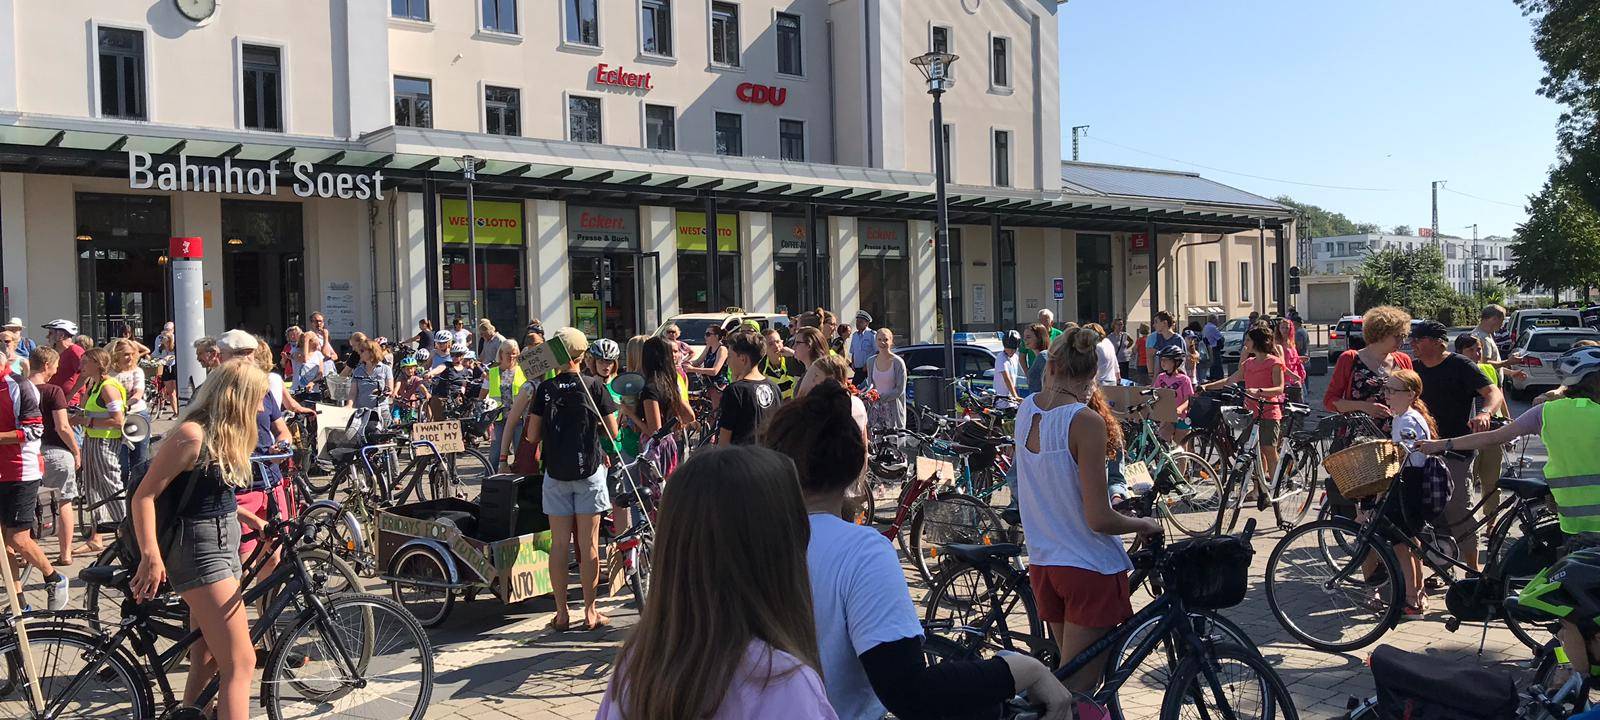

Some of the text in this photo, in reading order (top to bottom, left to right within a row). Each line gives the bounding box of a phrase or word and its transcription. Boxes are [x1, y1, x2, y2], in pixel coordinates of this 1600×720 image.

[595, 63, 654, 90] Eckert.
[735, 82, 788, 106] CDU
[128, 150, 385, 200] Bahnhof Soest
[421, 424, 444, 432] WANT
[446, 422, 459, 430] TO
[444, 431, 458, 441] MY
[382, 516, 448, 541] FRIDAYS FOR
[507, 570, 534, 601] AUTO
[1549, 570, 1567, 583] KED
